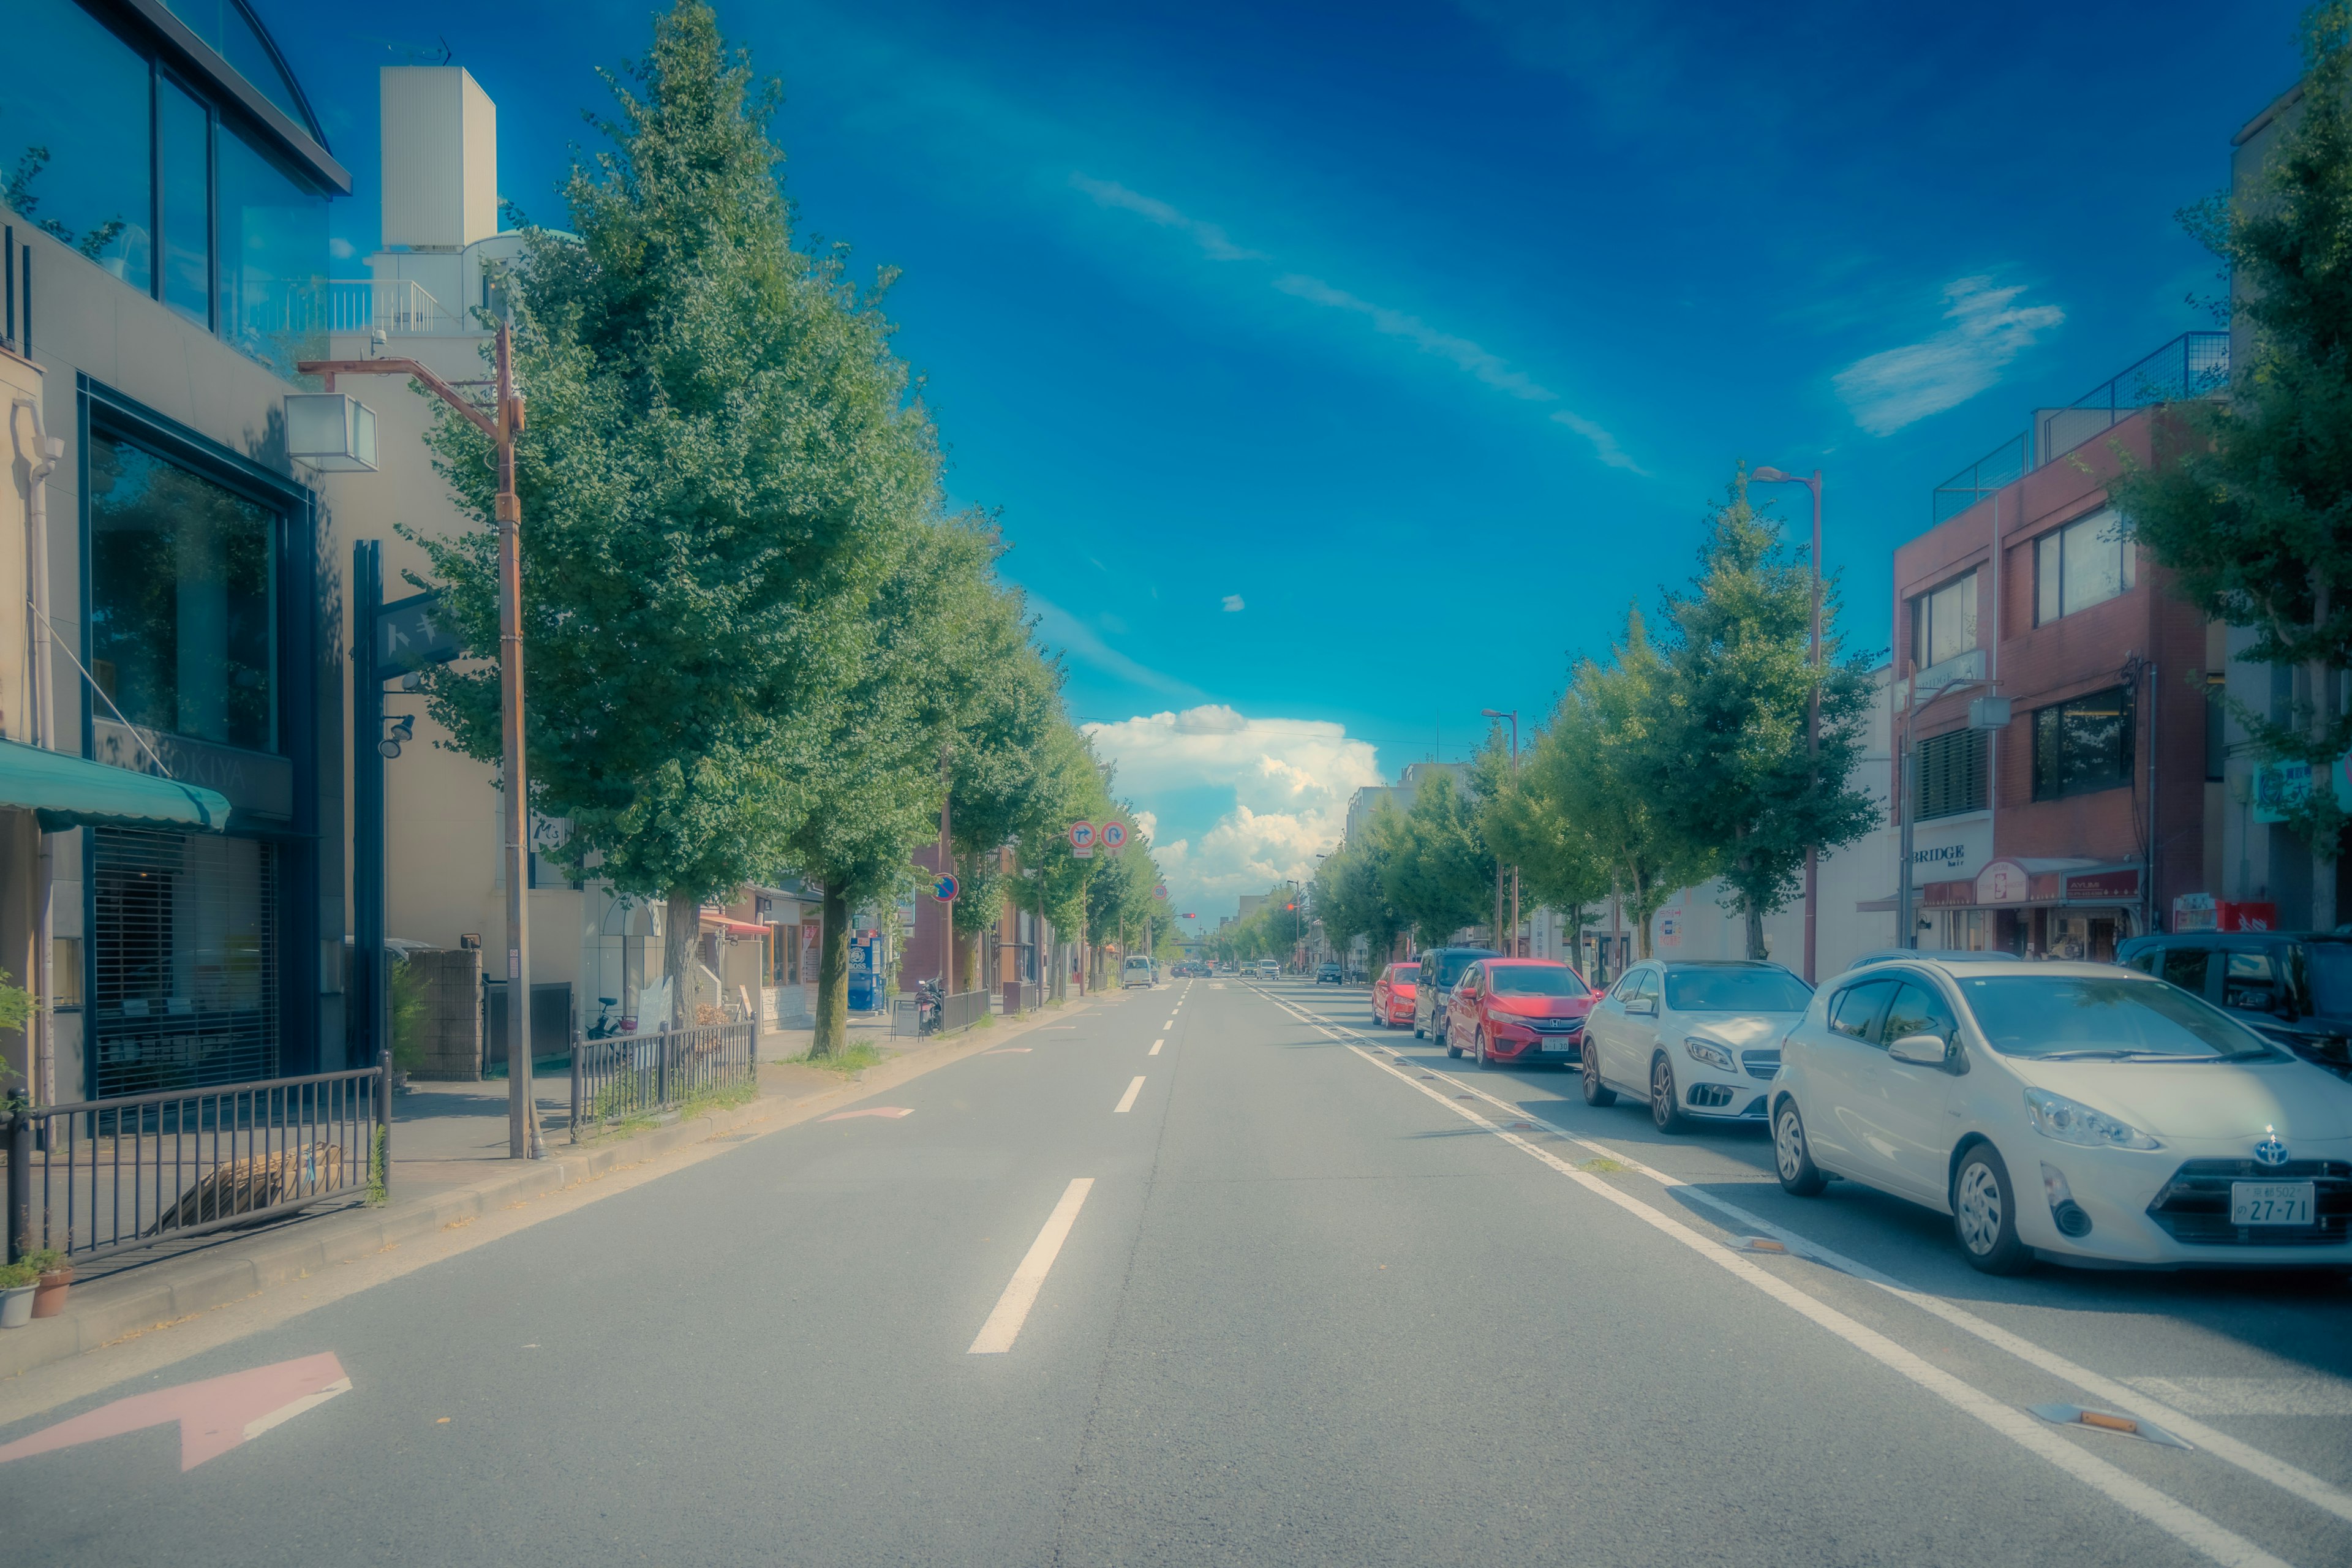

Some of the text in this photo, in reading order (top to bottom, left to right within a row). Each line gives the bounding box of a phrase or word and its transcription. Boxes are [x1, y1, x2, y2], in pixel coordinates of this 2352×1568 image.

[388, 606, 456, 658] トキ
[1912, 845, 1964, 863] BRIDGE
[2250, 1200, 2305, 1221] 27-71
